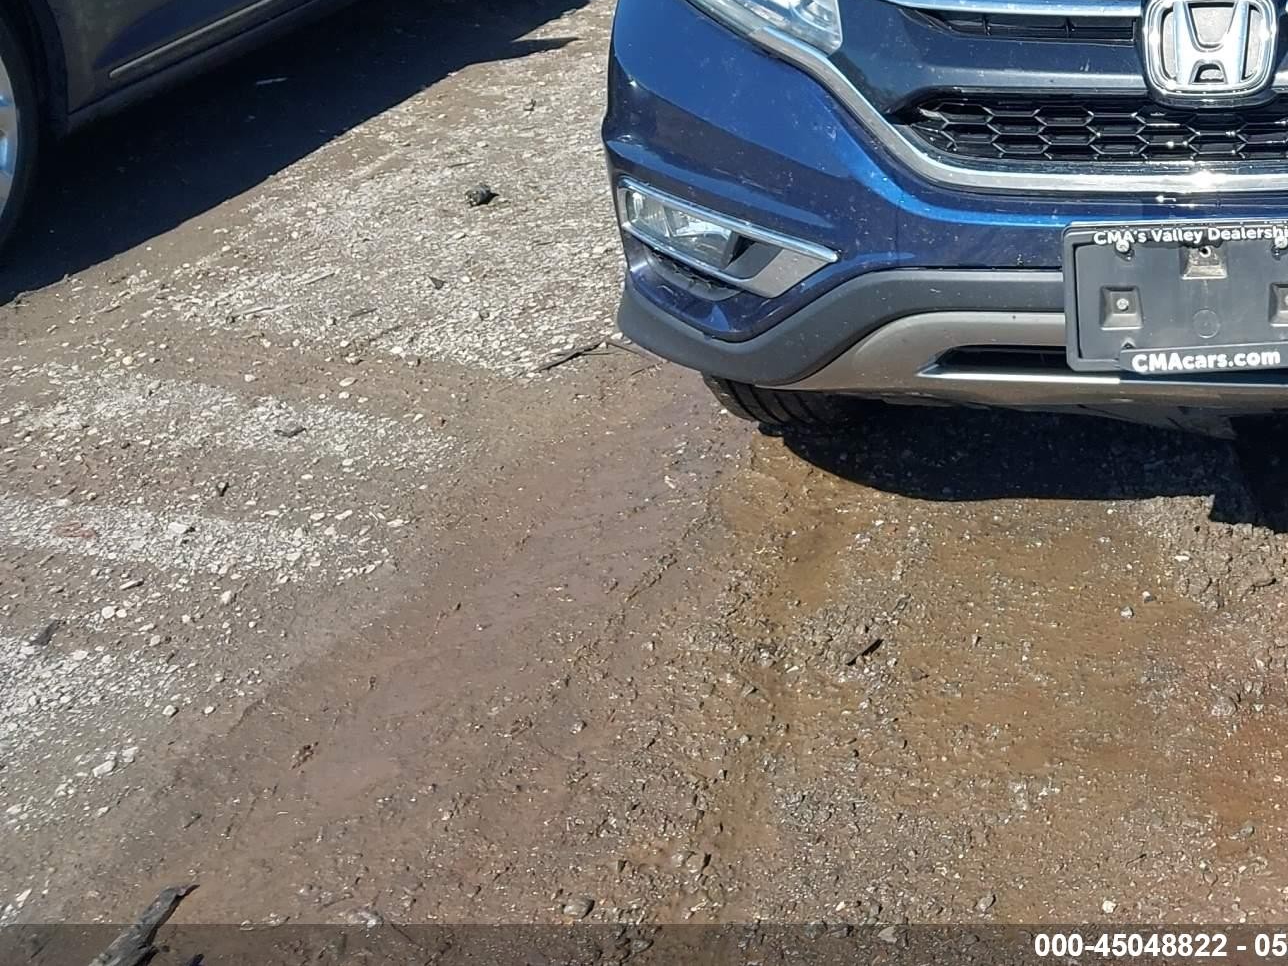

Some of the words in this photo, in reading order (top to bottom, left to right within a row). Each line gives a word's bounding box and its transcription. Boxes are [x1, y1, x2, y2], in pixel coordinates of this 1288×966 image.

[1093, 230, 1147, 245] CMA's
[1150, 227, 1204, 244] Valley
[1131, 349, 1281, 373] CMAcars.com
